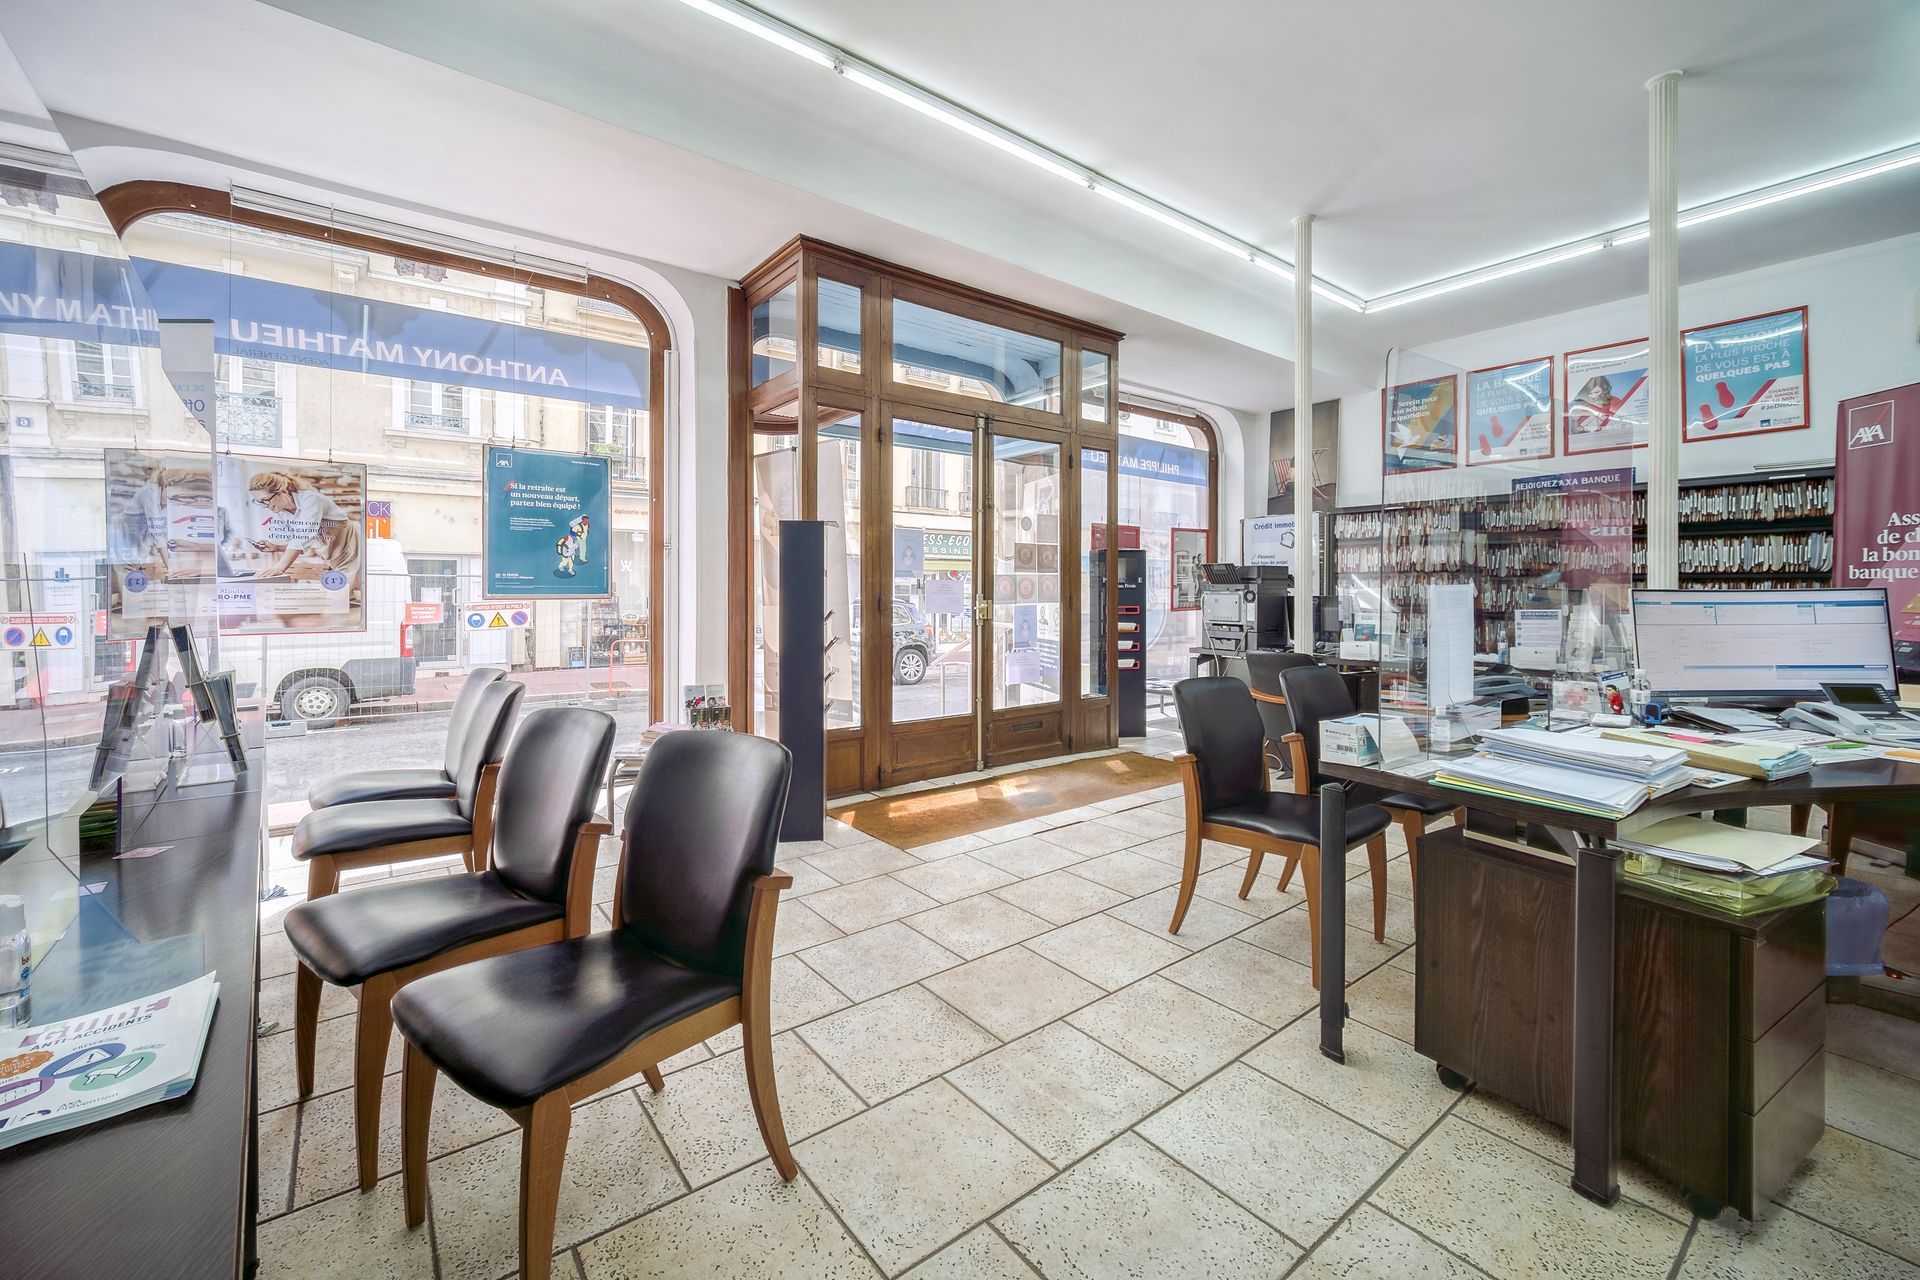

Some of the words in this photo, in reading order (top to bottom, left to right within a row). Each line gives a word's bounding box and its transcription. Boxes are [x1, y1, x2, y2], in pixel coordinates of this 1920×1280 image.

[56, 299, 161, 332] MATHI
[1695, 355, 1708, 363] LA
[1711, 348, 1739, 359] PLUS
[1742, 339, 1790, 354] PROCHE
[1696, 364, 1711, 374] DE
[1715, 358, 1749, 369] VOUS
[1753, 352, 1778, 363] EST
[1781, 349, 1790, 358] À
[1695, 365, 1760, 382] QUELQUES
[1764, 360, 1791, 370] PAS
[1477, 381, 1490, 391] LA
[1398, 399, 1420, 407] Serein
[1421, 396, 1439, 405] pour
[1405, 405, 1427, 413] achats
[1397, 410, 1430, 422] quotidien
[1477, 403, 1521, 416] QUELQUES
[1849, 424, 1884, 446] AXA
[527, 484, 554, 492] retraite
[1515, 480, 1560, 491] REJOIGNEZ
[1559, 478, 1579, 486] AXA
[1581, 474, 1620, 485] BANQUE
[510, 500, 534, 508] partez
[554, 493, 580, 502] départ,
[1254, 523, 1273, 531] Crédit
[1877, 529, 1900, 544] de
[1862, 547, 1878, 562] la
[1849, 565, 1919, 583] banque
[30, 1013, 153, 1051] ANTI-ACCIDENTS
